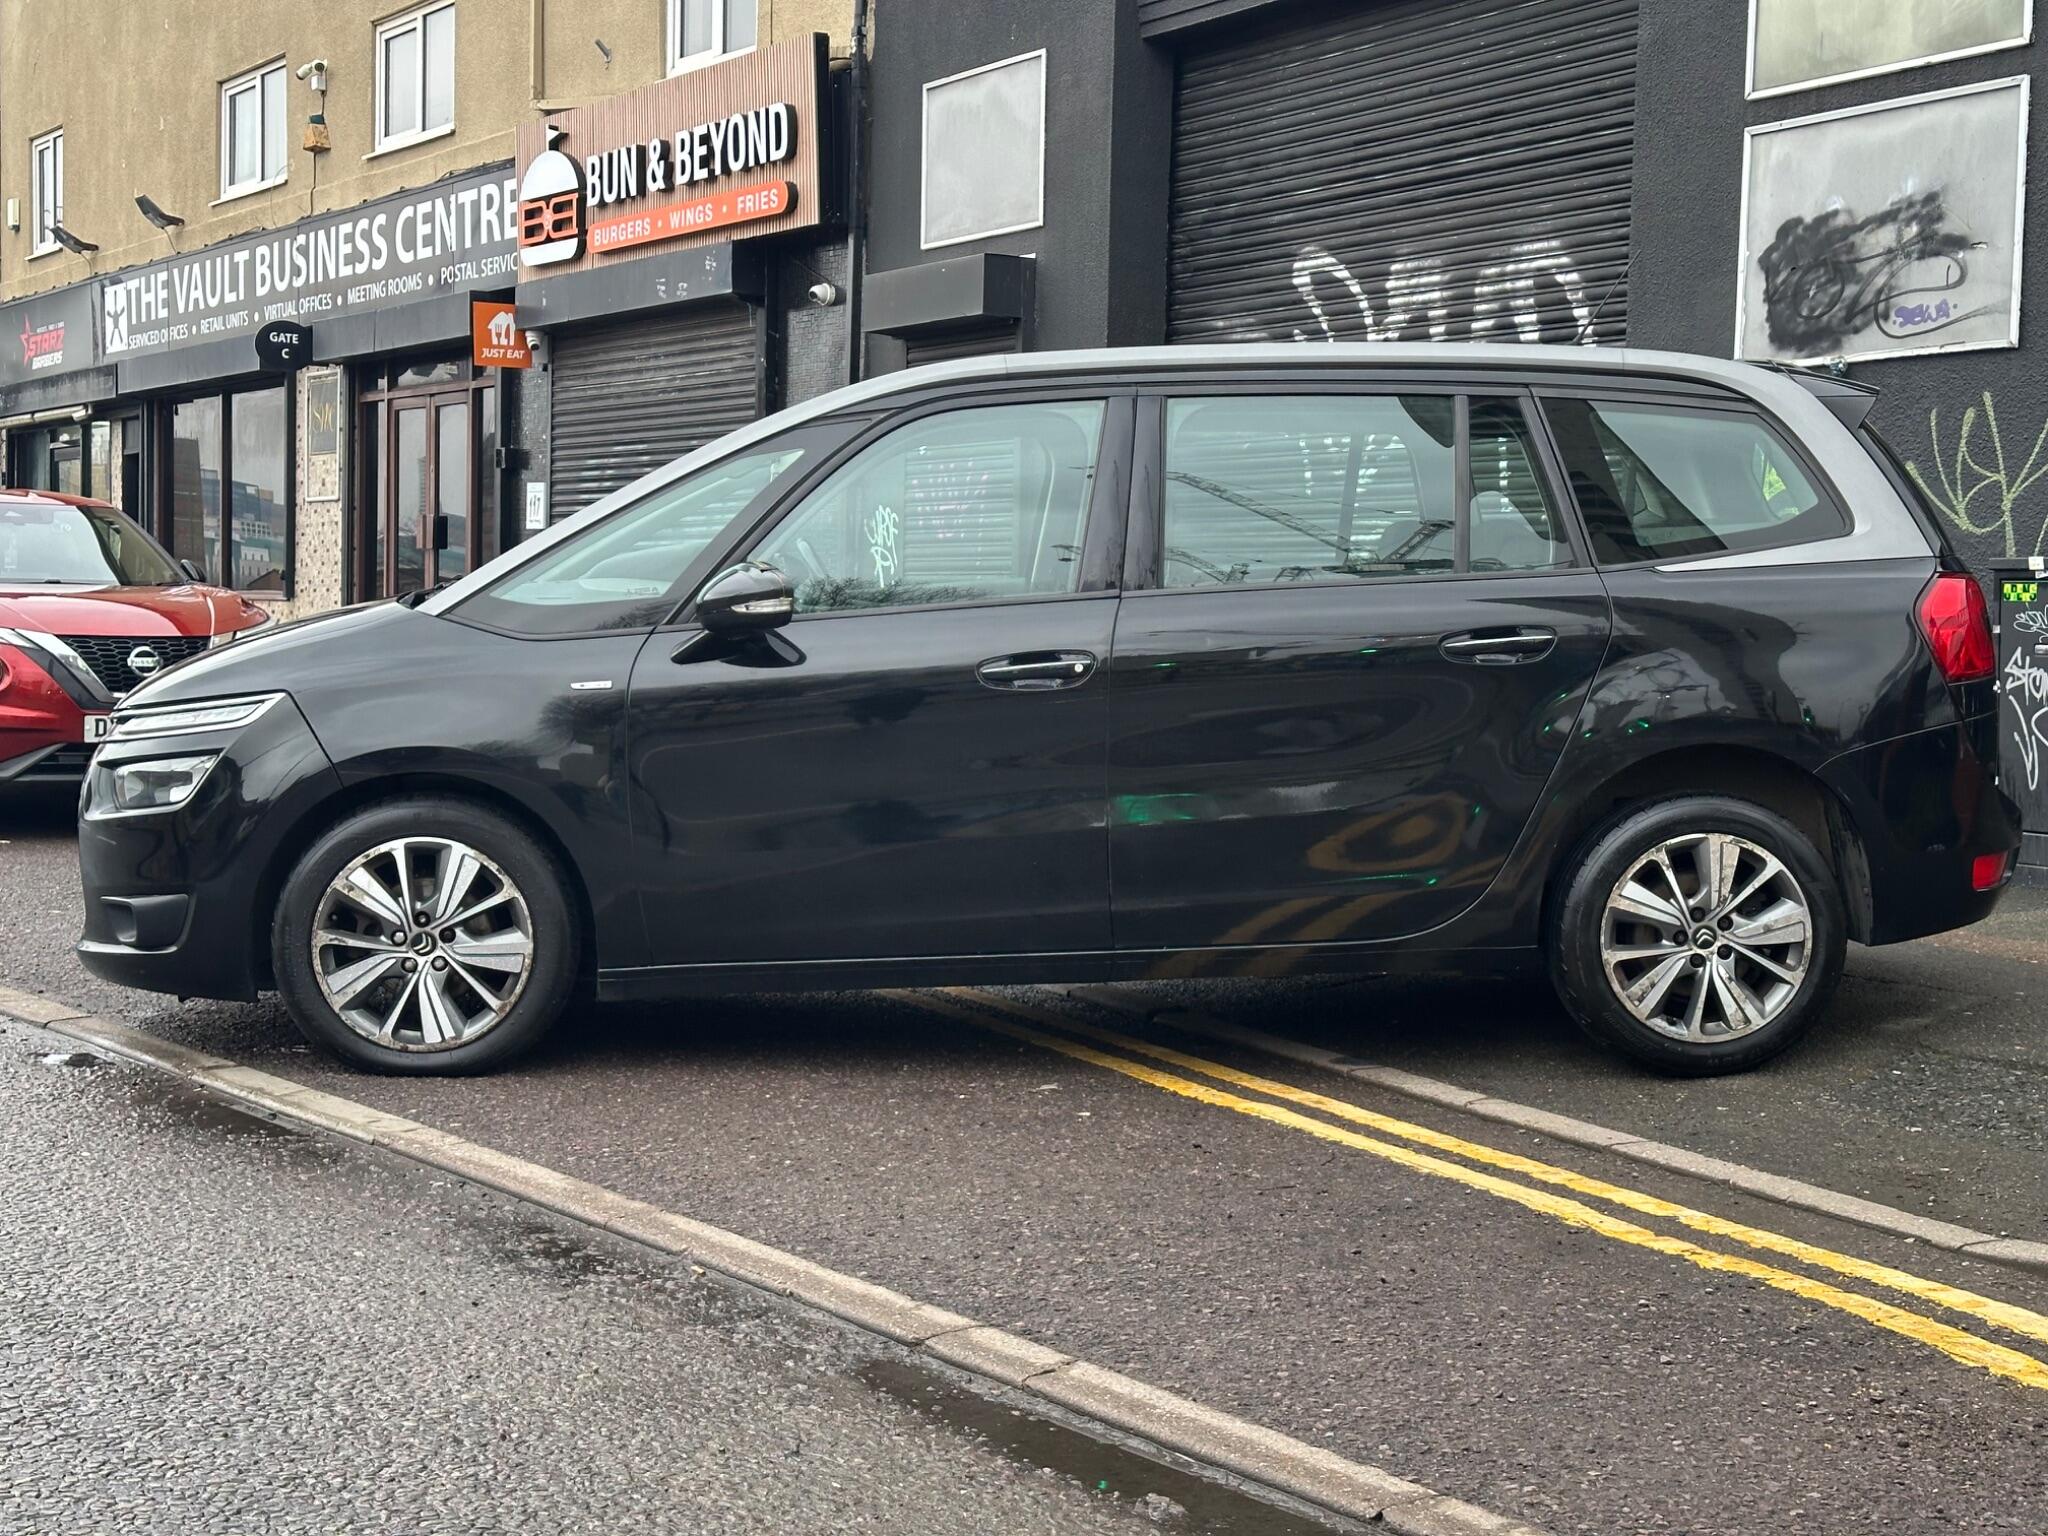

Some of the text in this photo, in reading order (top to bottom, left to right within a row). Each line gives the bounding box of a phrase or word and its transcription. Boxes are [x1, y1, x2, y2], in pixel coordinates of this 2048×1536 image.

[586, 102, 790, 208] BUN & BEYOND
[593, 187, 779, 246] BURGERS WINGS FRIES
[127, 178, 518, 325] THE VAULT BUSINESS CENTRE
[128, 330, 160, 350] SERVICED
[200, 316, 225, 335] RETAIL
[226, 310, 249, 331] UNITS
[264, 299, 298, 321] VIRTUAL
[298, 292, 332, 315] OFFICES
[347, 281, 386, 304] MEETING
[388, 273, 422, 296] ROOMS
[441, 261, 479, 285] POSTAL
[27, 327, 65, 357] STARZ
[269, 332, 299, 344] GATE
[281, 348, 290, 359] C
[481, 348, 525, 359] JUST EAT
